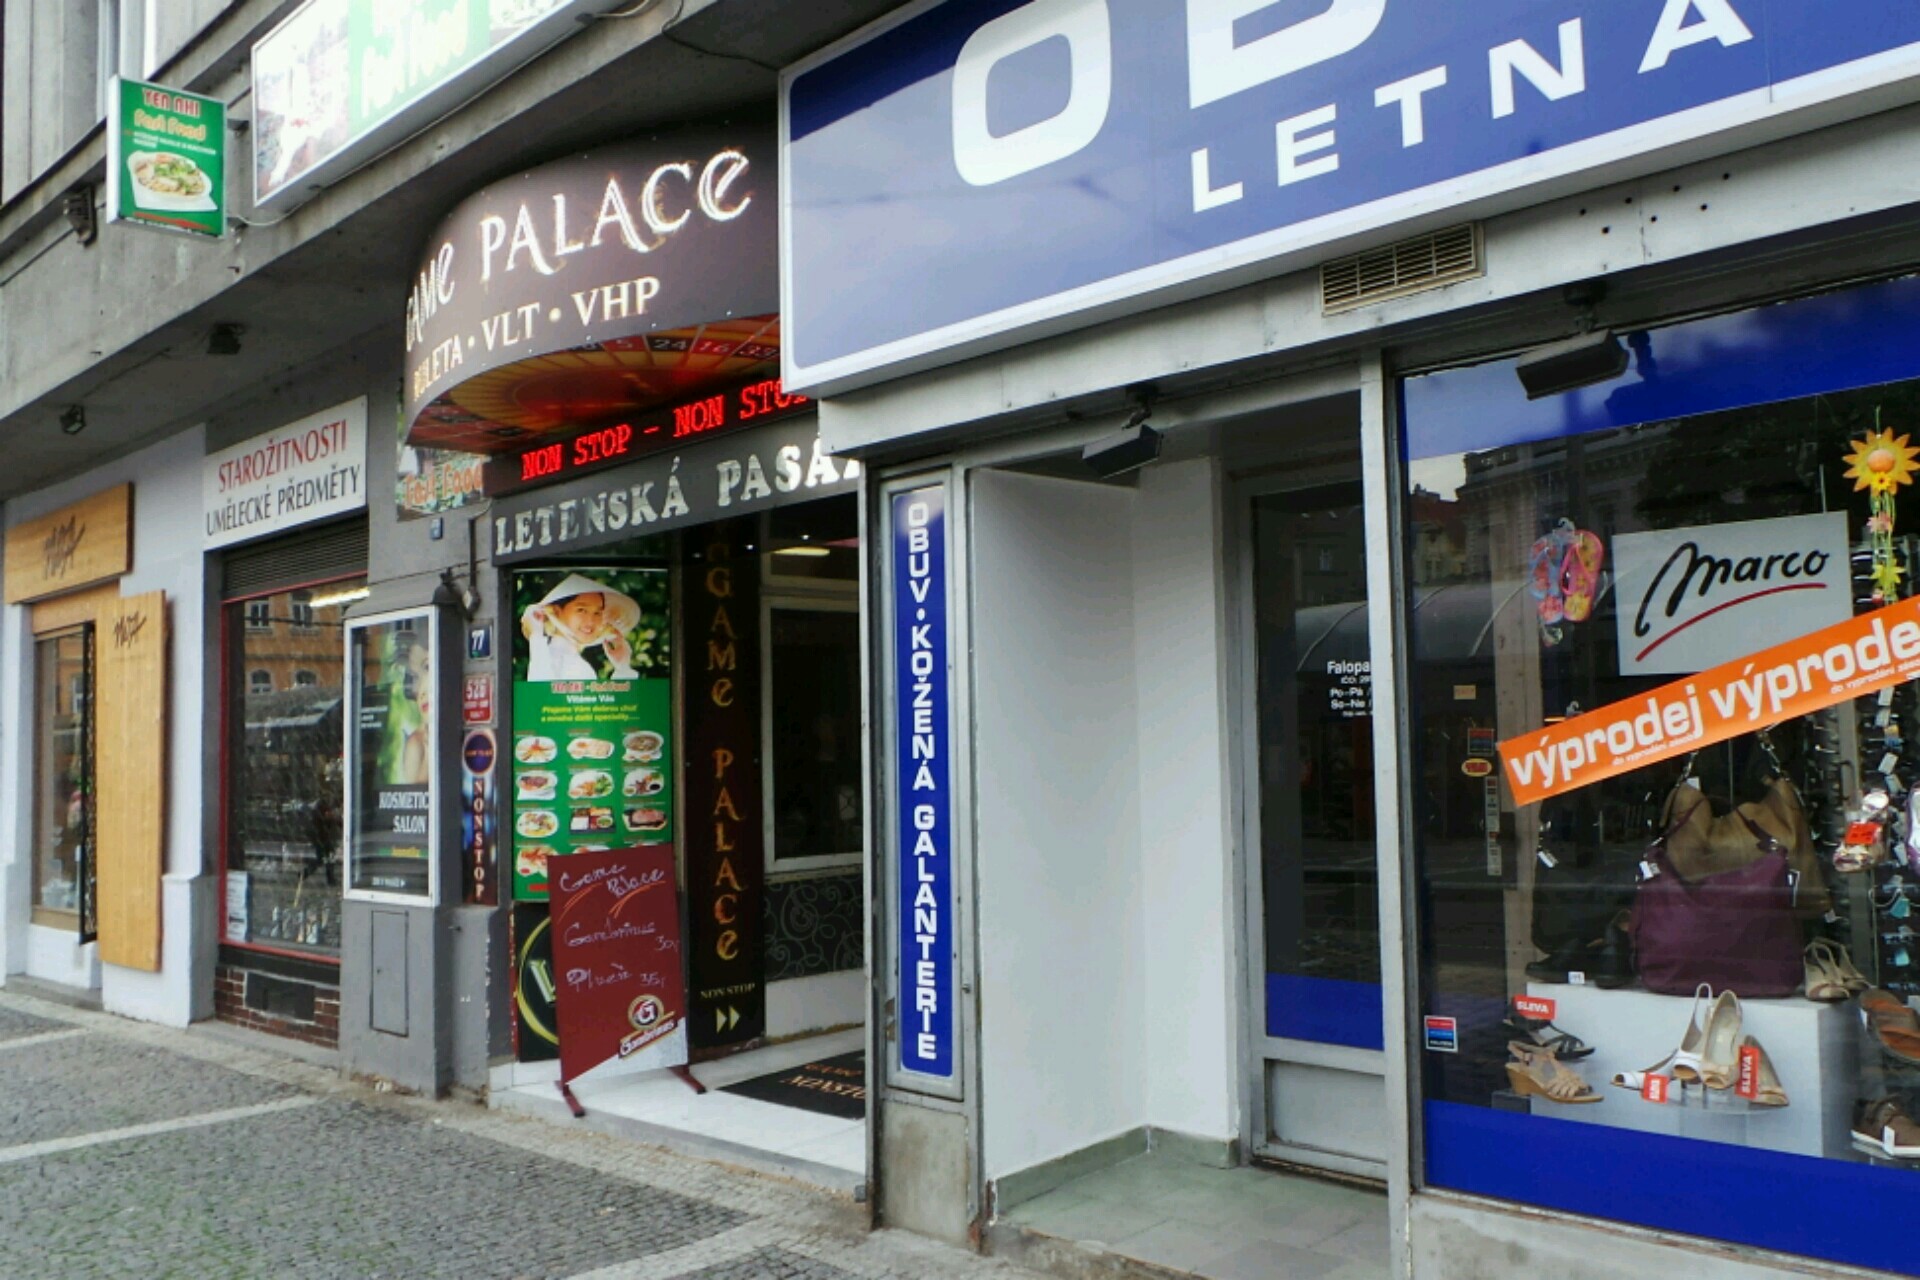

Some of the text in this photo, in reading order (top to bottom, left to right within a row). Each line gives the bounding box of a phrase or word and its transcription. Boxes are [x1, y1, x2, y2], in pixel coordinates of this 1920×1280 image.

[481, 302, 541, 351] VLT
[572, 276, 661, 327] VHP
[219, 419, 347, 492] STAROŽITNOSTI
[522, 444, 563, 481] NON
[574, 424, 632, 466] STOP
[673, 394, 725, 437] NON
[739, 377, 809, 420] STO
[206, 462, 360, 537] UMĚLECKÉ PŘEDMĚTY
[495, 456, 690, 557] LETENSKÁ
[471, 629, 486, 651] 77
[1509, 606, 1920, 789] výprodej výprode
[908, 502, 938, 1060] OBUV KOŽENÁ GALANTERIE
[393, 815, 426, 834] SALON
[1516, 1001, 1549, 1014] SLEVA
